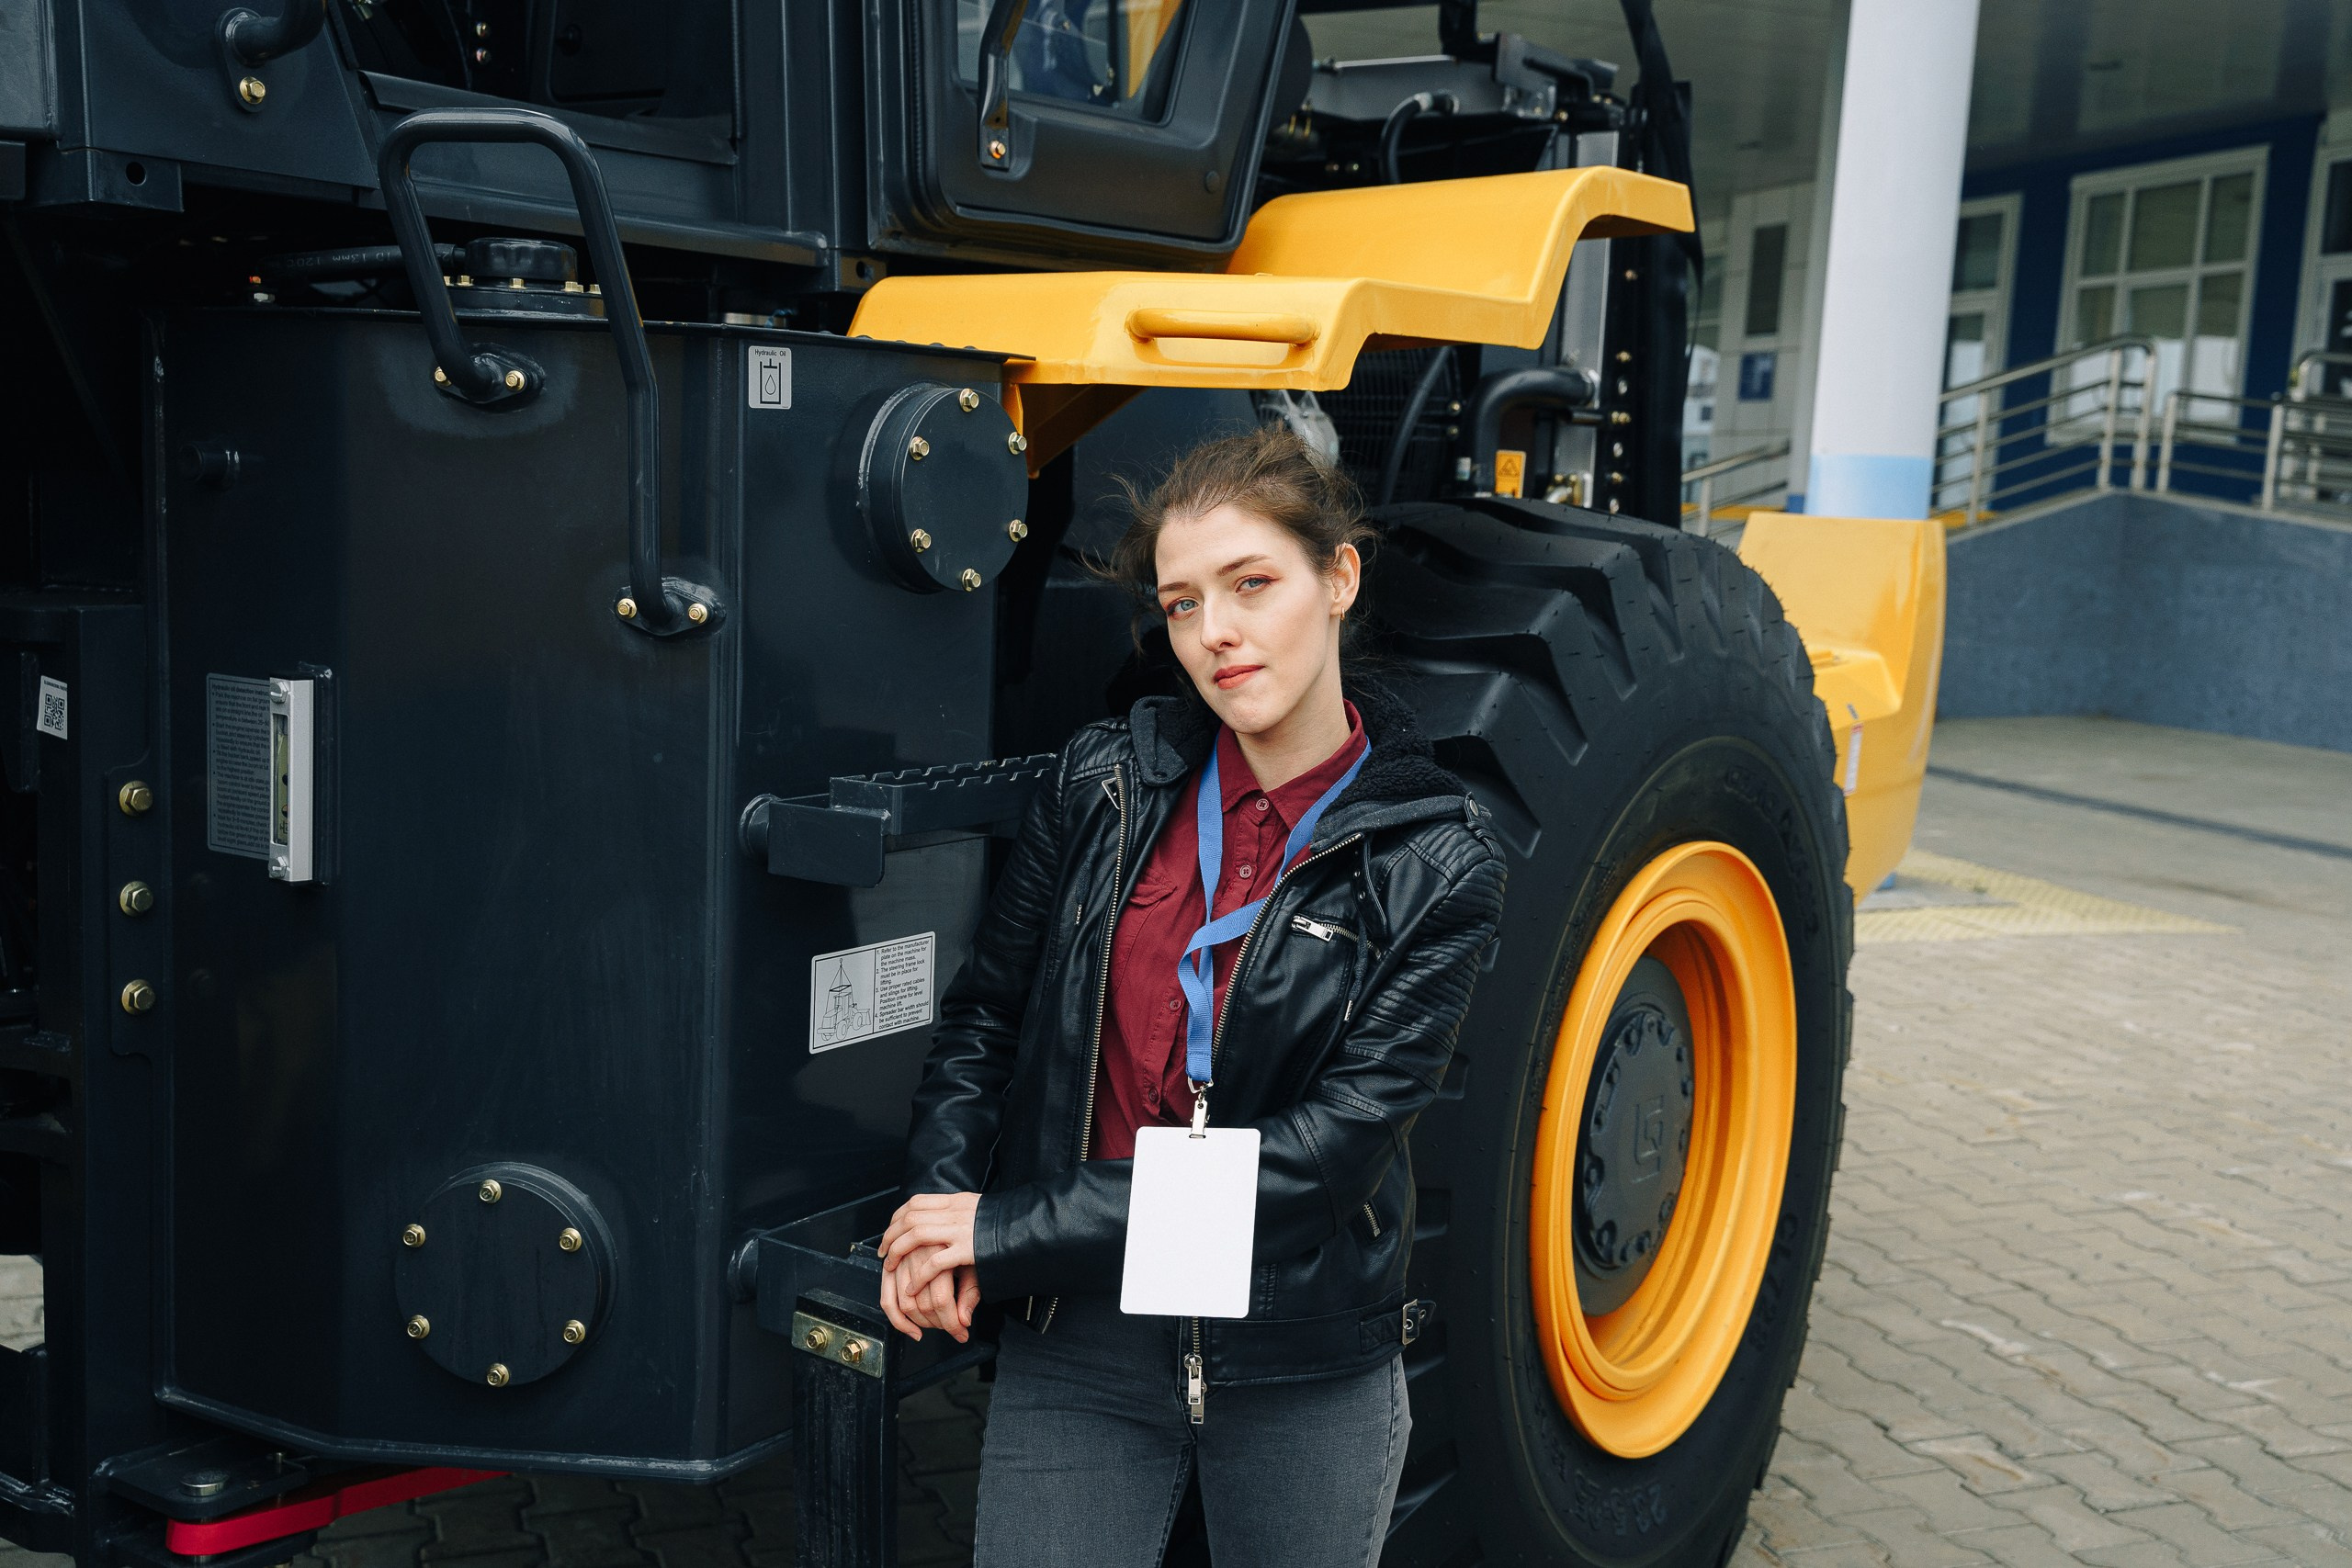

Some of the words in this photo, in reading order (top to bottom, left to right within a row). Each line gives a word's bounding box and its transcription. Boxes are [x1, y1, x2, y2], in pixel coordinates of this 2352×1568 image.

[905, 940, 929, 949] manufacturer
[905, 947, 920, 955] machine
[889, 963, 904, 971] steering
[888, 982, 901, 990] proper
[880, 996, 895, 1004] Position
[879, 1002, 896, 1010] machine
[879, 1009, 897, 1017] Spreader
[885, 1013, 902, 1022] sufficient
[879, 1021, 893, 1030] contact
